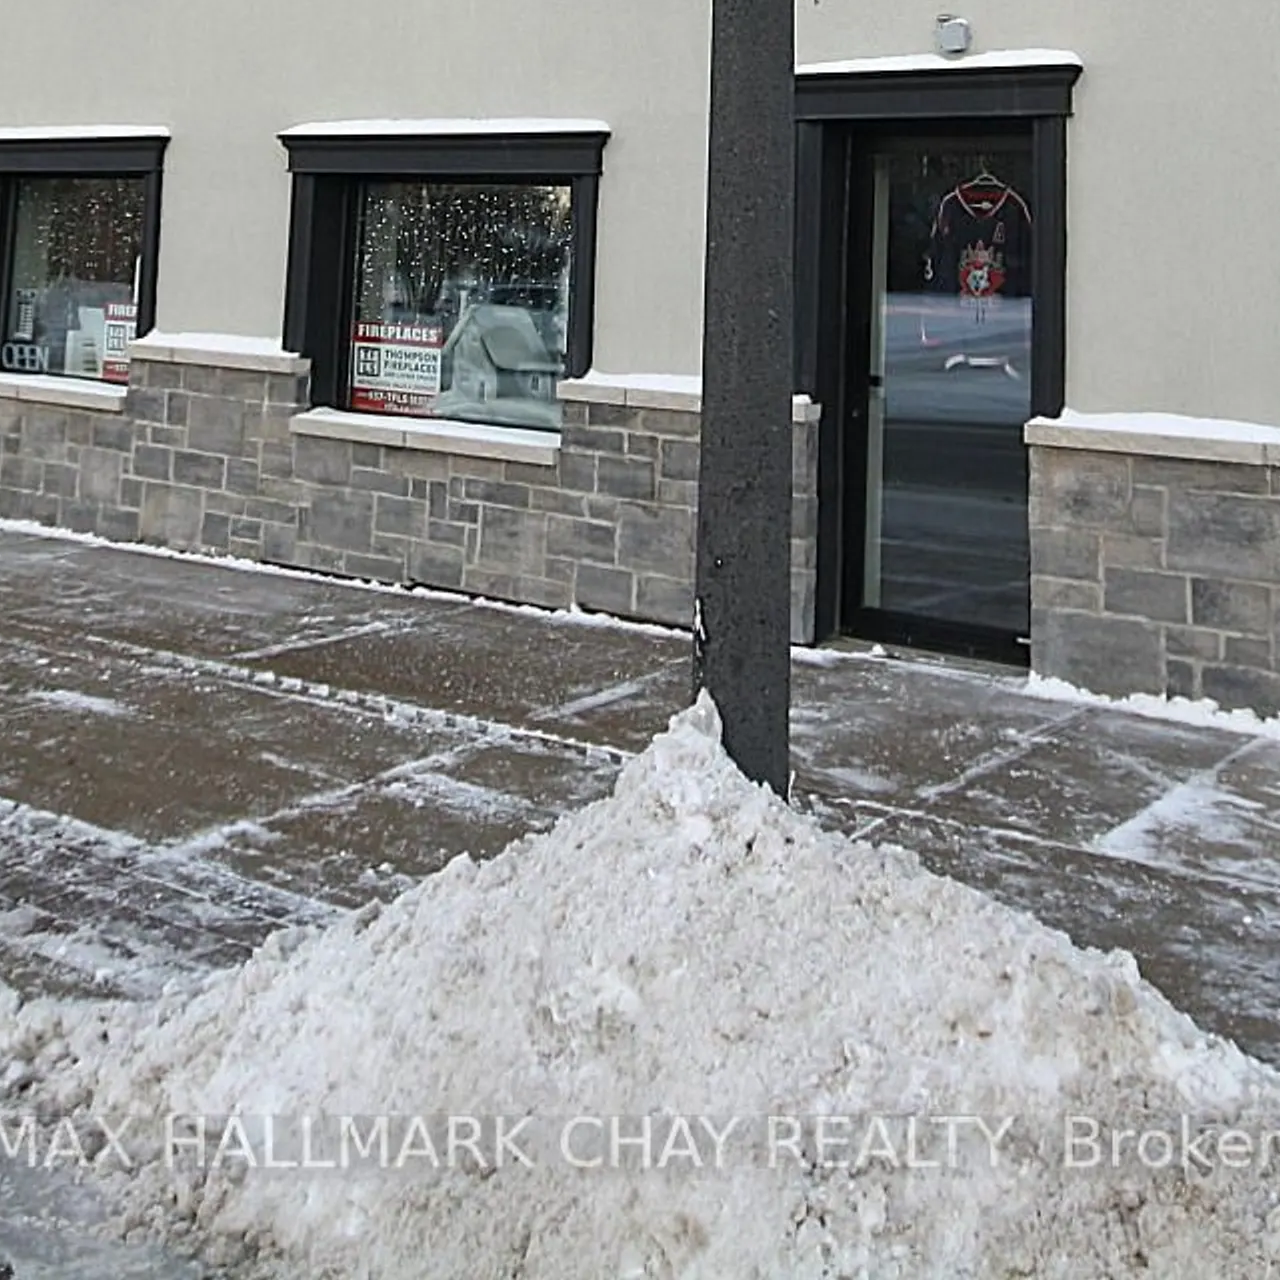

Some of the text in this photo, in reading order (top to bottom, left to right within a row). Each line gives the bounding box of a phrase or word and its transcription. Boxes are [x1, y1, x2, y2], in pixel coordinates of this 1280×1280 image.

[2, 343, 50, 371] OPEN
[383, 349, 438, 363] THOMPSON
[383, 360, 438, 374] FIREPLACES
